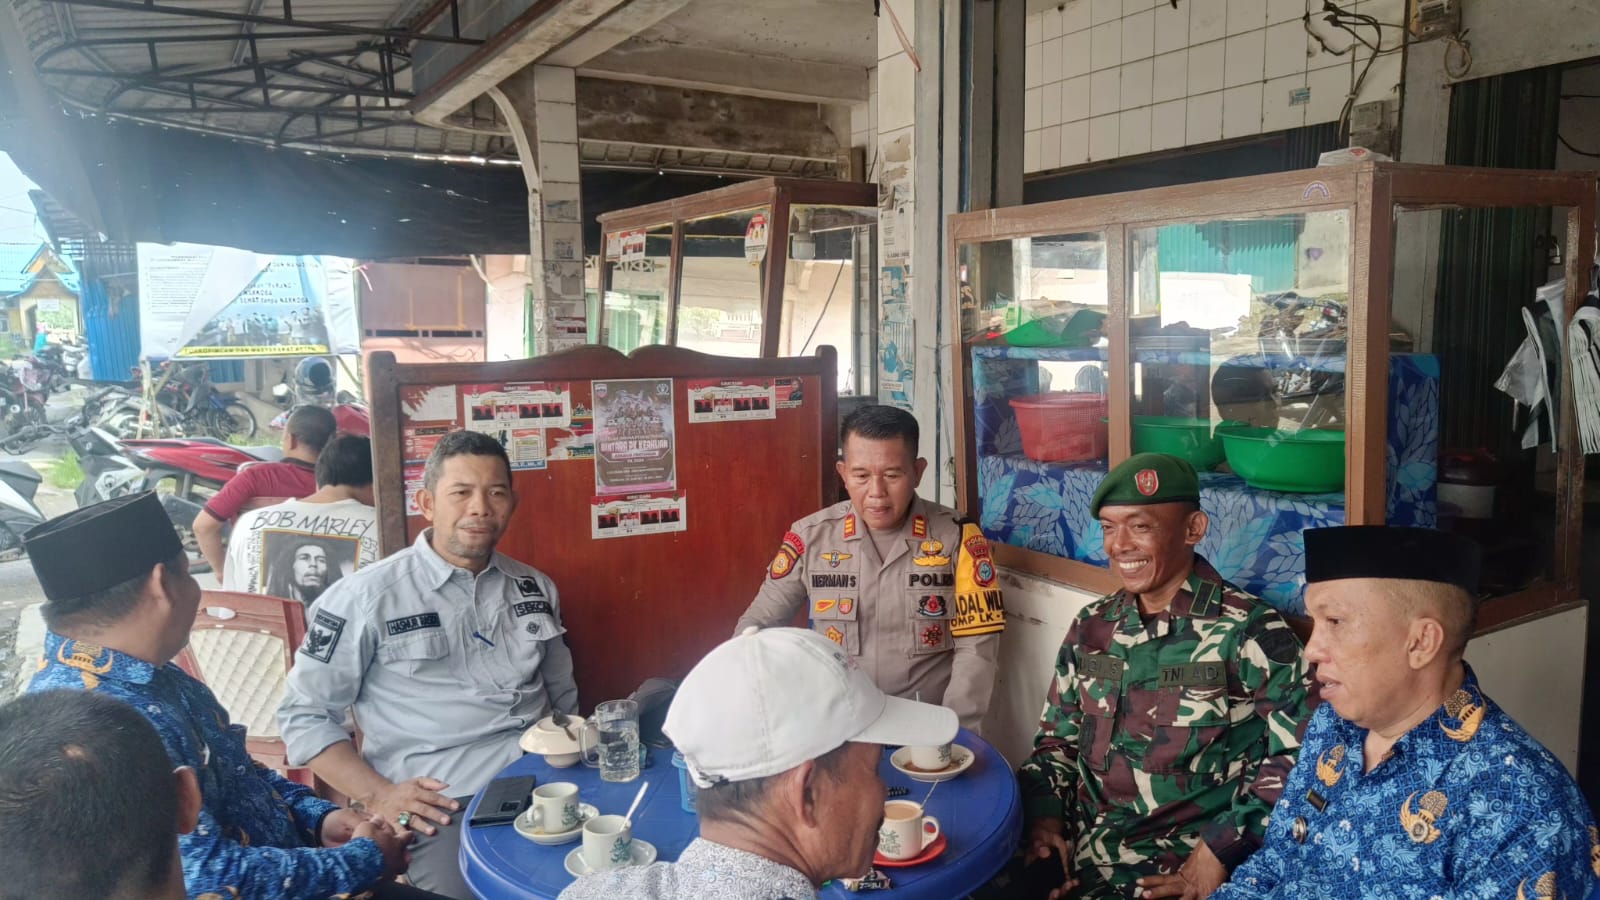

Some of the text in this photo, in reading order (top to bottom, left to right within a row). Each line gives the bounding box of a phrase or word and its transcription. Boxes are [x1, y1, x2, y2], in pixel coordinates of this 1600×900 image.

[250, 511, 375, 539] BOB MARLEY
[812, 574, 856, 587] HERMAN S
[1163, 665, 1219, 682] TNI AD
